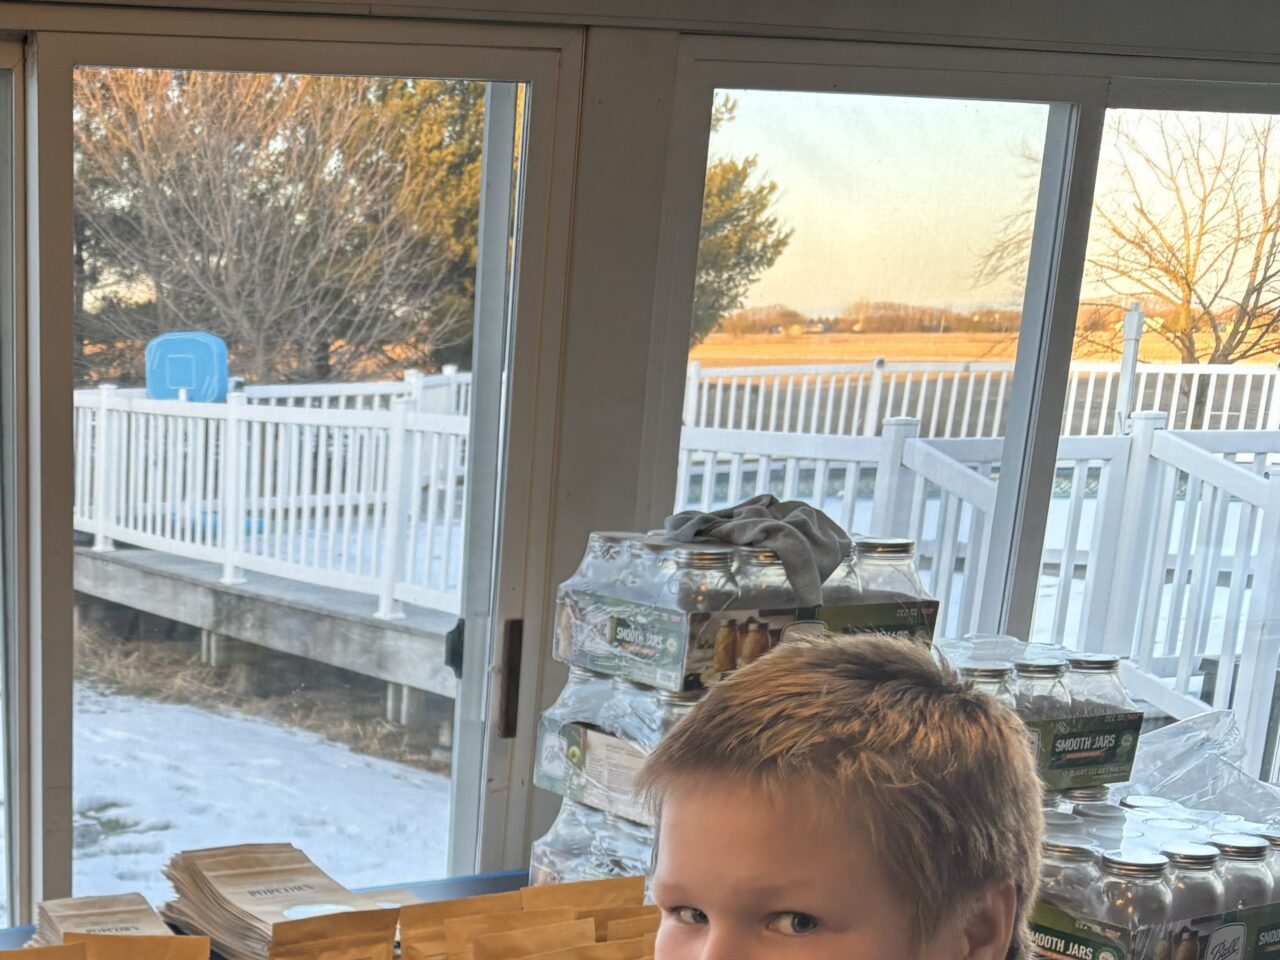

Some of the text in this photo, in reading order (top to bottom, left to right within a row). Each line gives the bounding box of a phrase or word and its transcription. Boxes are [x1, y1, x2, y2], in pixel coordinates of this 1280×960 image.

[1055, 734, 1115, 752] SMOOTH JARS
[247, 884, 315, 897] POPCORN
[1031, 931, 1065, 952] MOOTH
[1066, 942, 1094, 960] JARS
[1259, 928, 1280, 946] SMOO
